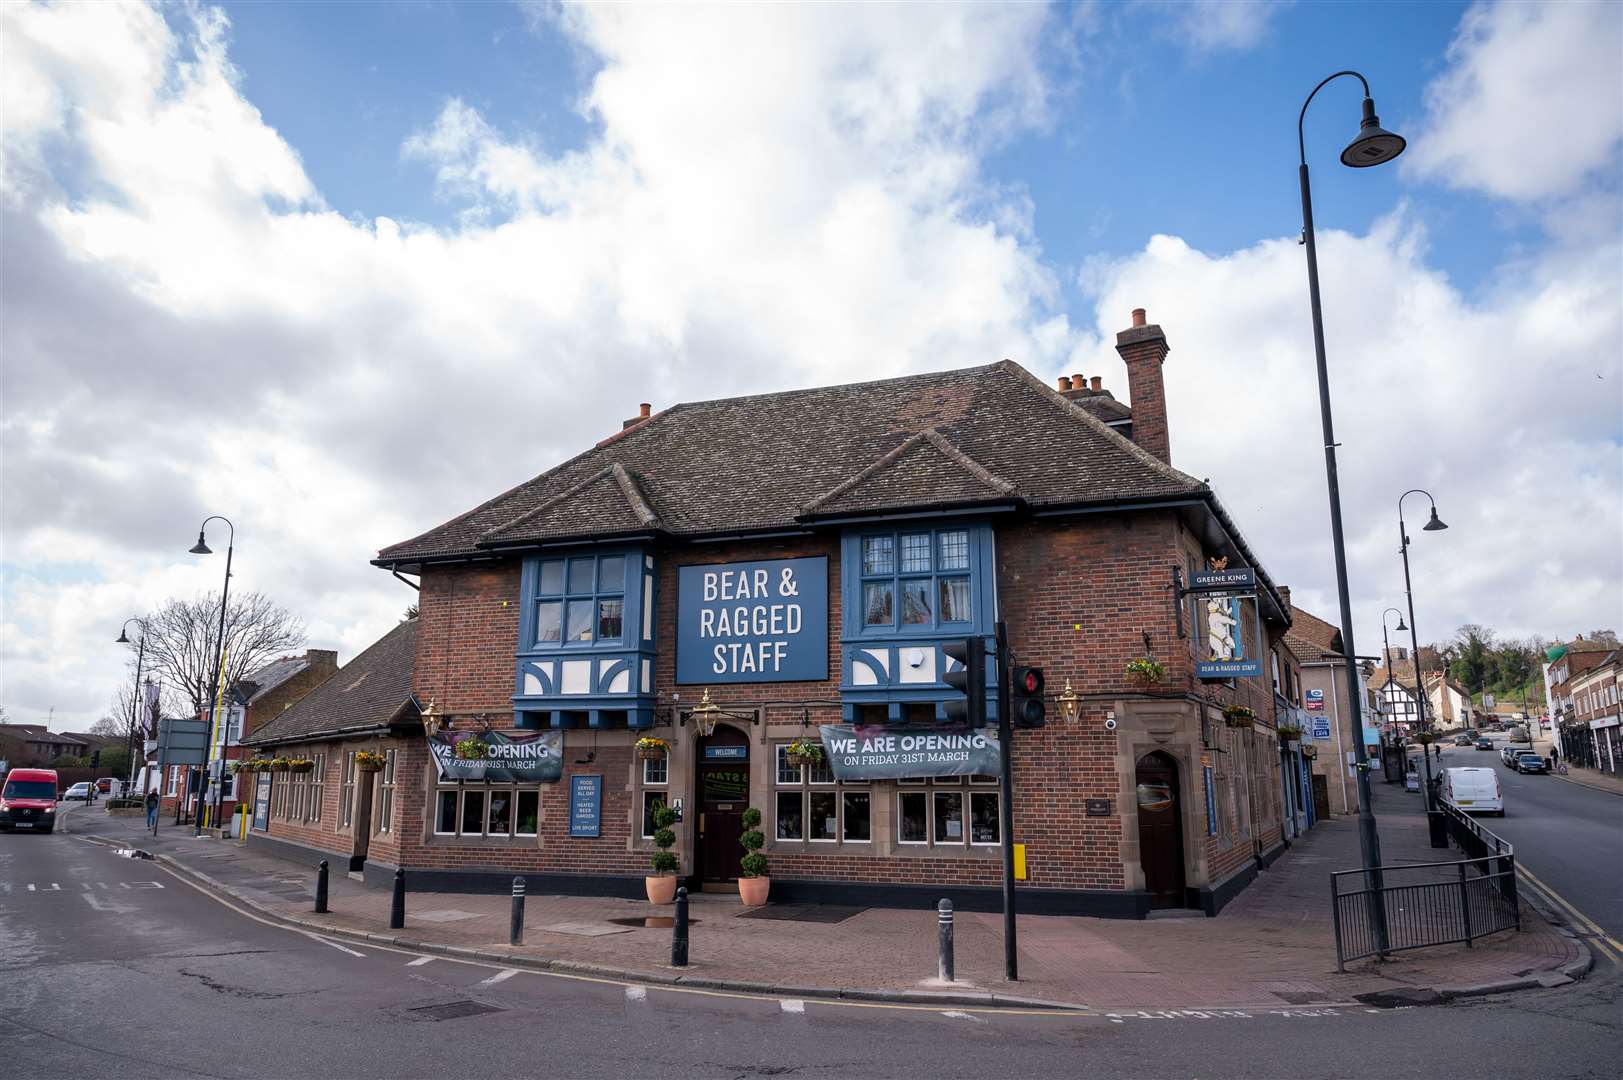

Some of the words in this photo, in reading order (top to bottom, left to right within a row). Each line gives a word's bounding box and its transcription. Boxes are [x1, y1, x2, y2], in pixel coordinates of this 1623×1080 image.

[703, 569, 769, 602] BEAR
[779, 567, 799, 597] &
[1196, 575, 1226, 583] GREENE
[1227, 574, 1248, 582] KING
[700, 604, 802, 638] RAGGED
[713, 641, 789, 674] STAFF
[432, 743, 452, 757] WE
[487, 743, 548, 759] OPENING
[715, 748, 738, 756] WELCOME
[830, 738, 857, 754] WE
[861, 736, 896, 753] ARE
[901, 735, 987, 751] OPENING
[452, 759, 487, 768] FRIDAY
[843, 755, 859, 766] ON
[862, 754, 900, 766] FRIDAY
[901, 752, 925, 764] 31ST
[927, 751, 969, 763] MARCH
